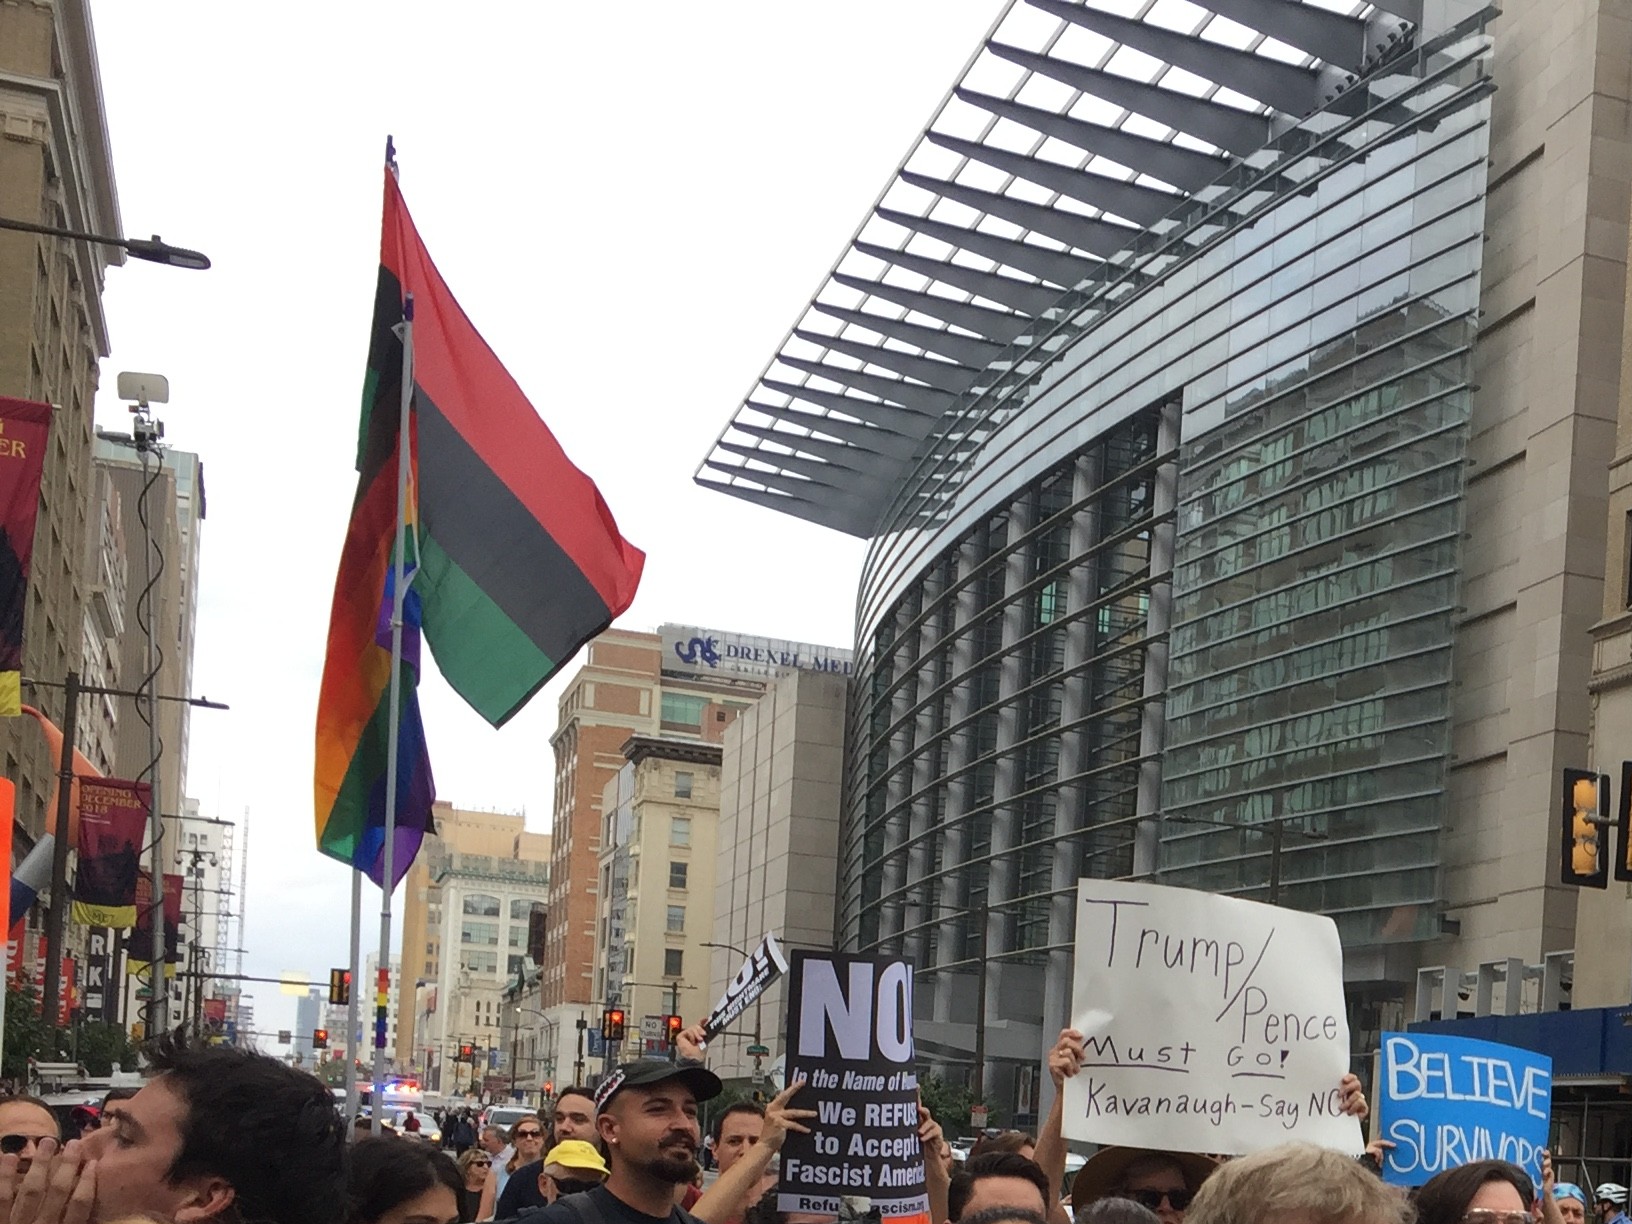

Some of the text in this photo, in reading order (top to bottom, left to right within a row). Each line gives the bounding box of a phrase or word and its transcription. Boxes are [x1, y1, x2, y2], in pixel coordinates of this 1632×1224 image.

[726, 644, 854, 675] DREXEL MED
[1241, 986, 1338, 1044] Pence
[1082, 1035, 1196, 1064] Must
[812, 1069, 838, 1089] the
[842, 1070, 884, 1091] Name
[888, 1071, 900, 1091] of
[1386, 1037, 1550, 1119] BELIEVE
[818, 1101, 917, 1127] We REFUS
[814, 1131, 839, 1155] to
[848, 1133, 915, 1161] Accept
[1388, 1119, 1545, 1189] SURVIVORS
[786, 1159, 872, 1187] Fascist
